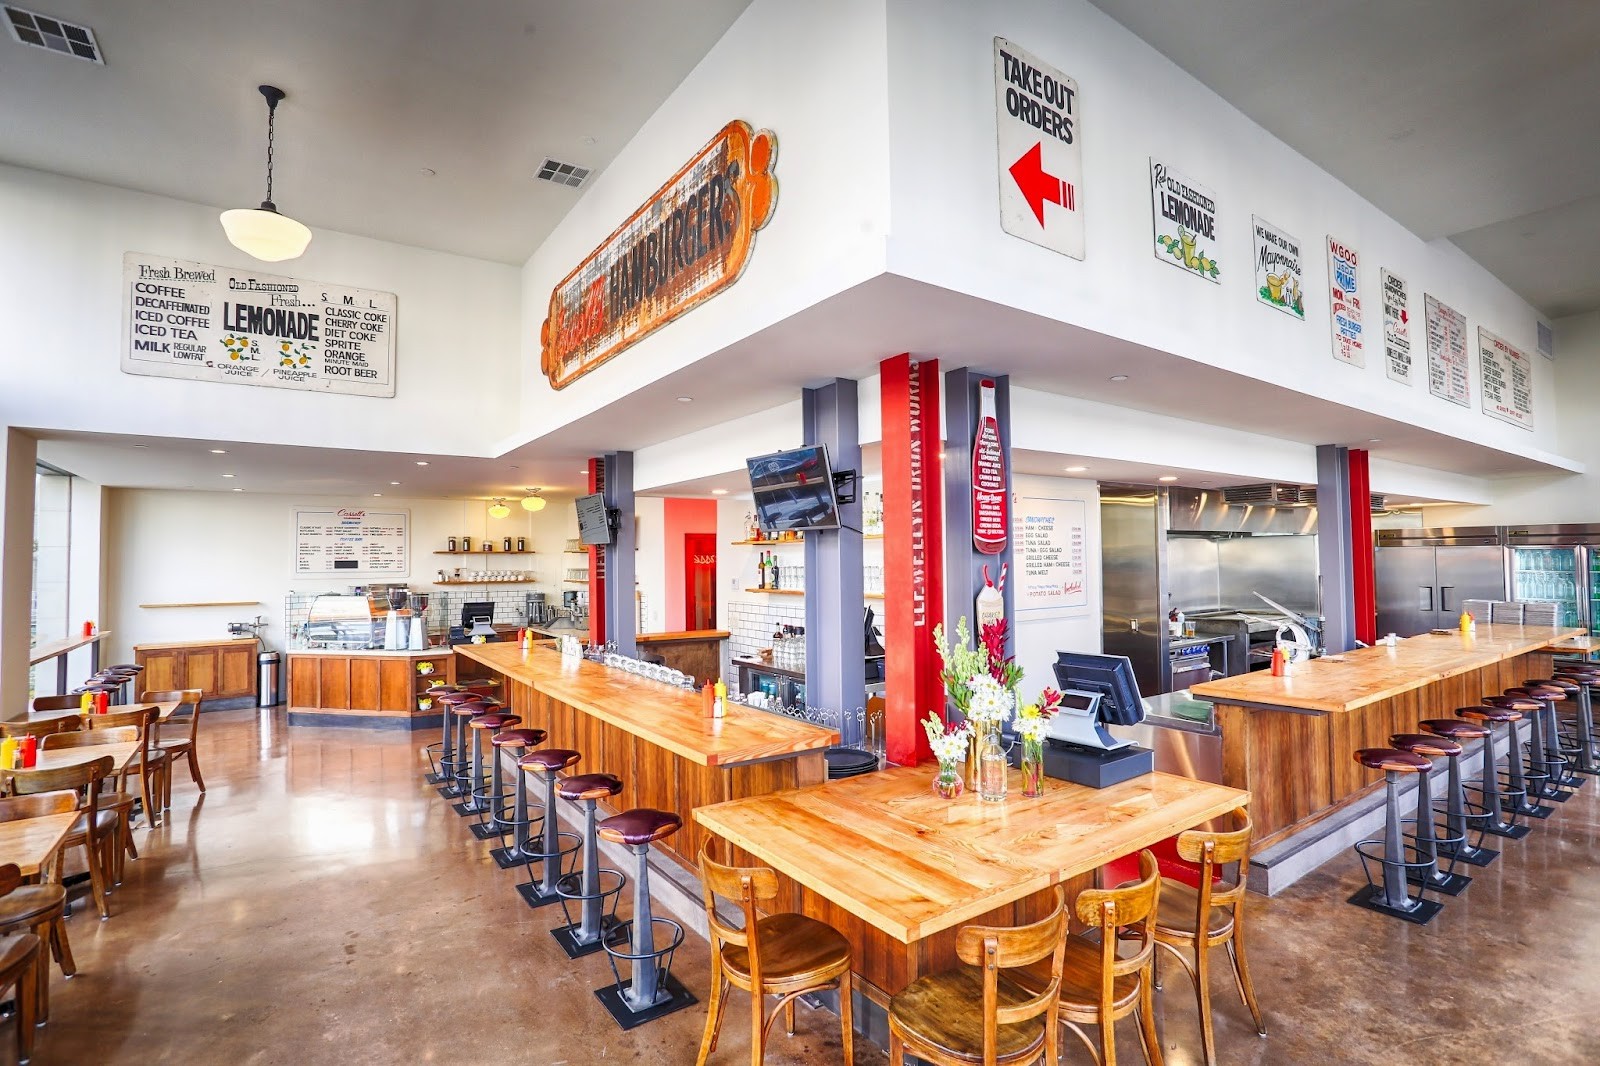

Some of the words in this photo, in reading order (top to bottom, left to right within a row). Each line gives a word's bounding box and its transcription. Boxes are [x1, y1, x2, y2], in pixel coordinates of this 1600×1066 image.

[1006, 87, 1073, 144] ORDERS
[1167, 177, 1180, 195] OLD
[1161, 191, 1215, 241] LEMONADE
[1256, 225, 1264, 239] WE
[1278, 237, 1288, 250] OUR
[1289, 243, 1299, 257] OWN
[1257, 245, 1301, 276] Mayonnaise
[1336, 261, 1353, 276] USDA
[138, 264, 171, 279] Fresh
[174, 266, 215, 282] Brewed
[1336, 270, 1355, 290] PRIME
[135, 282, 186, 299] COFFEE
[229, 277, 246, 291] OLD
[248, 279, 299, 293] FASHIONED
[135, 296, 210, 315] DECAFFEINATED
[135, 310, 163, 323] ICED
[167, 314, 210, 329] COFFEE
[223, 301, 320, 341] LEMONADE
[325, 306, 361, 320] CLASSIC
[363, 311, 387, 323] COKE
[135, 323, 167, 337] ICED
[170, 327, 199, 341] TEA
[325, 318, 358, 331] CHERRY
[360, 322, 383, 333] COKE
[325, 328, 346, 340] DIET
[349, 331, 376, 342] COKE
[134, 340, 171, 354] MILK
[173, 342, 207, 353] REGULAR
[325, 339, 361, 351] SPRITE
[173, 351, 204, 361] LOWFAT
[324, 349, 365, 362] ORANGE
[217, 363, 260, 373] ORANGE
[224, 369, 253, 377] JUICE
[273, 368, 317, 379] PINEAPPLE
[324, 365, 352, 377] ROOT
[354, 368, 378, 379] BEER
[278, 374, 305, 382] JUICE
